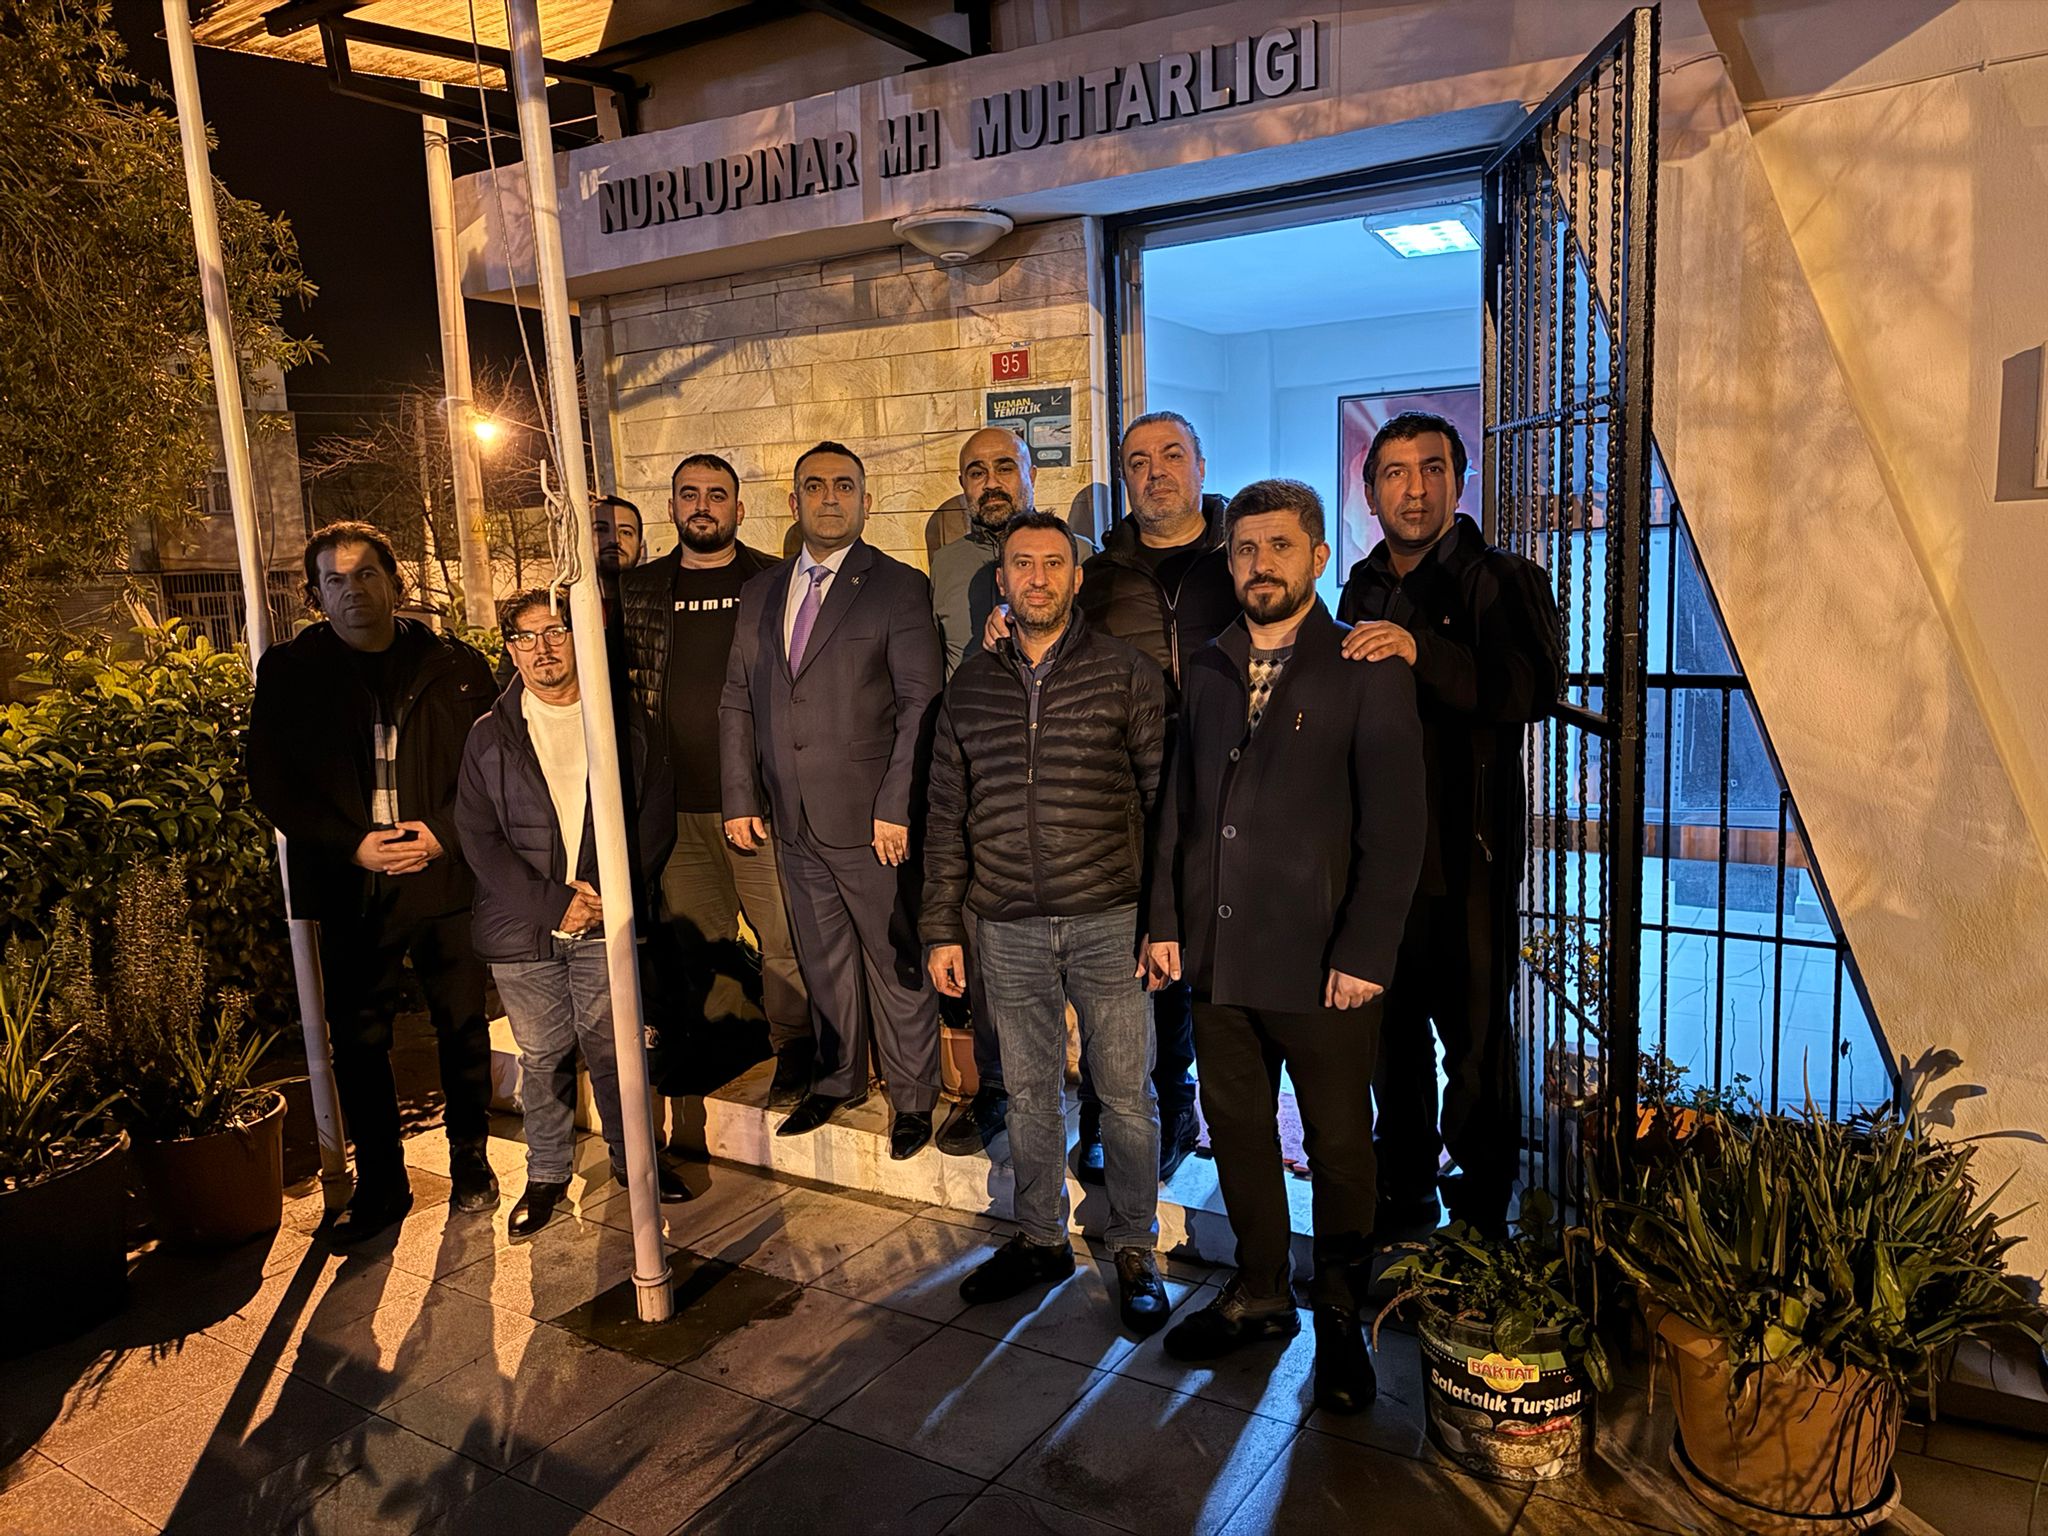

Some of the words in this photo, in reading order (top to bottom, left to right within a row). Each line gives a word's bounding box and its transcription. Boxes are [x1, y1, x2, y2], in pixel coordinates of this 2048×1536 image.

[598, 131, 860, 234] NURLUPINAR
[879, 110, 941, 179] MH
[971, 20, 1320, 160] MUHTARLIGI
[1001, 353, 1021, 374] 95
[993, 397, 1031, 410] UZMAN
[674, 598, 733, 612] PUMA
[1470, 1361, 1535, 1381] BAKTAT
[1431, 1368, 1507, 1413] Salatalık
[1511, 1389, 1582, 1417] Turşusu
